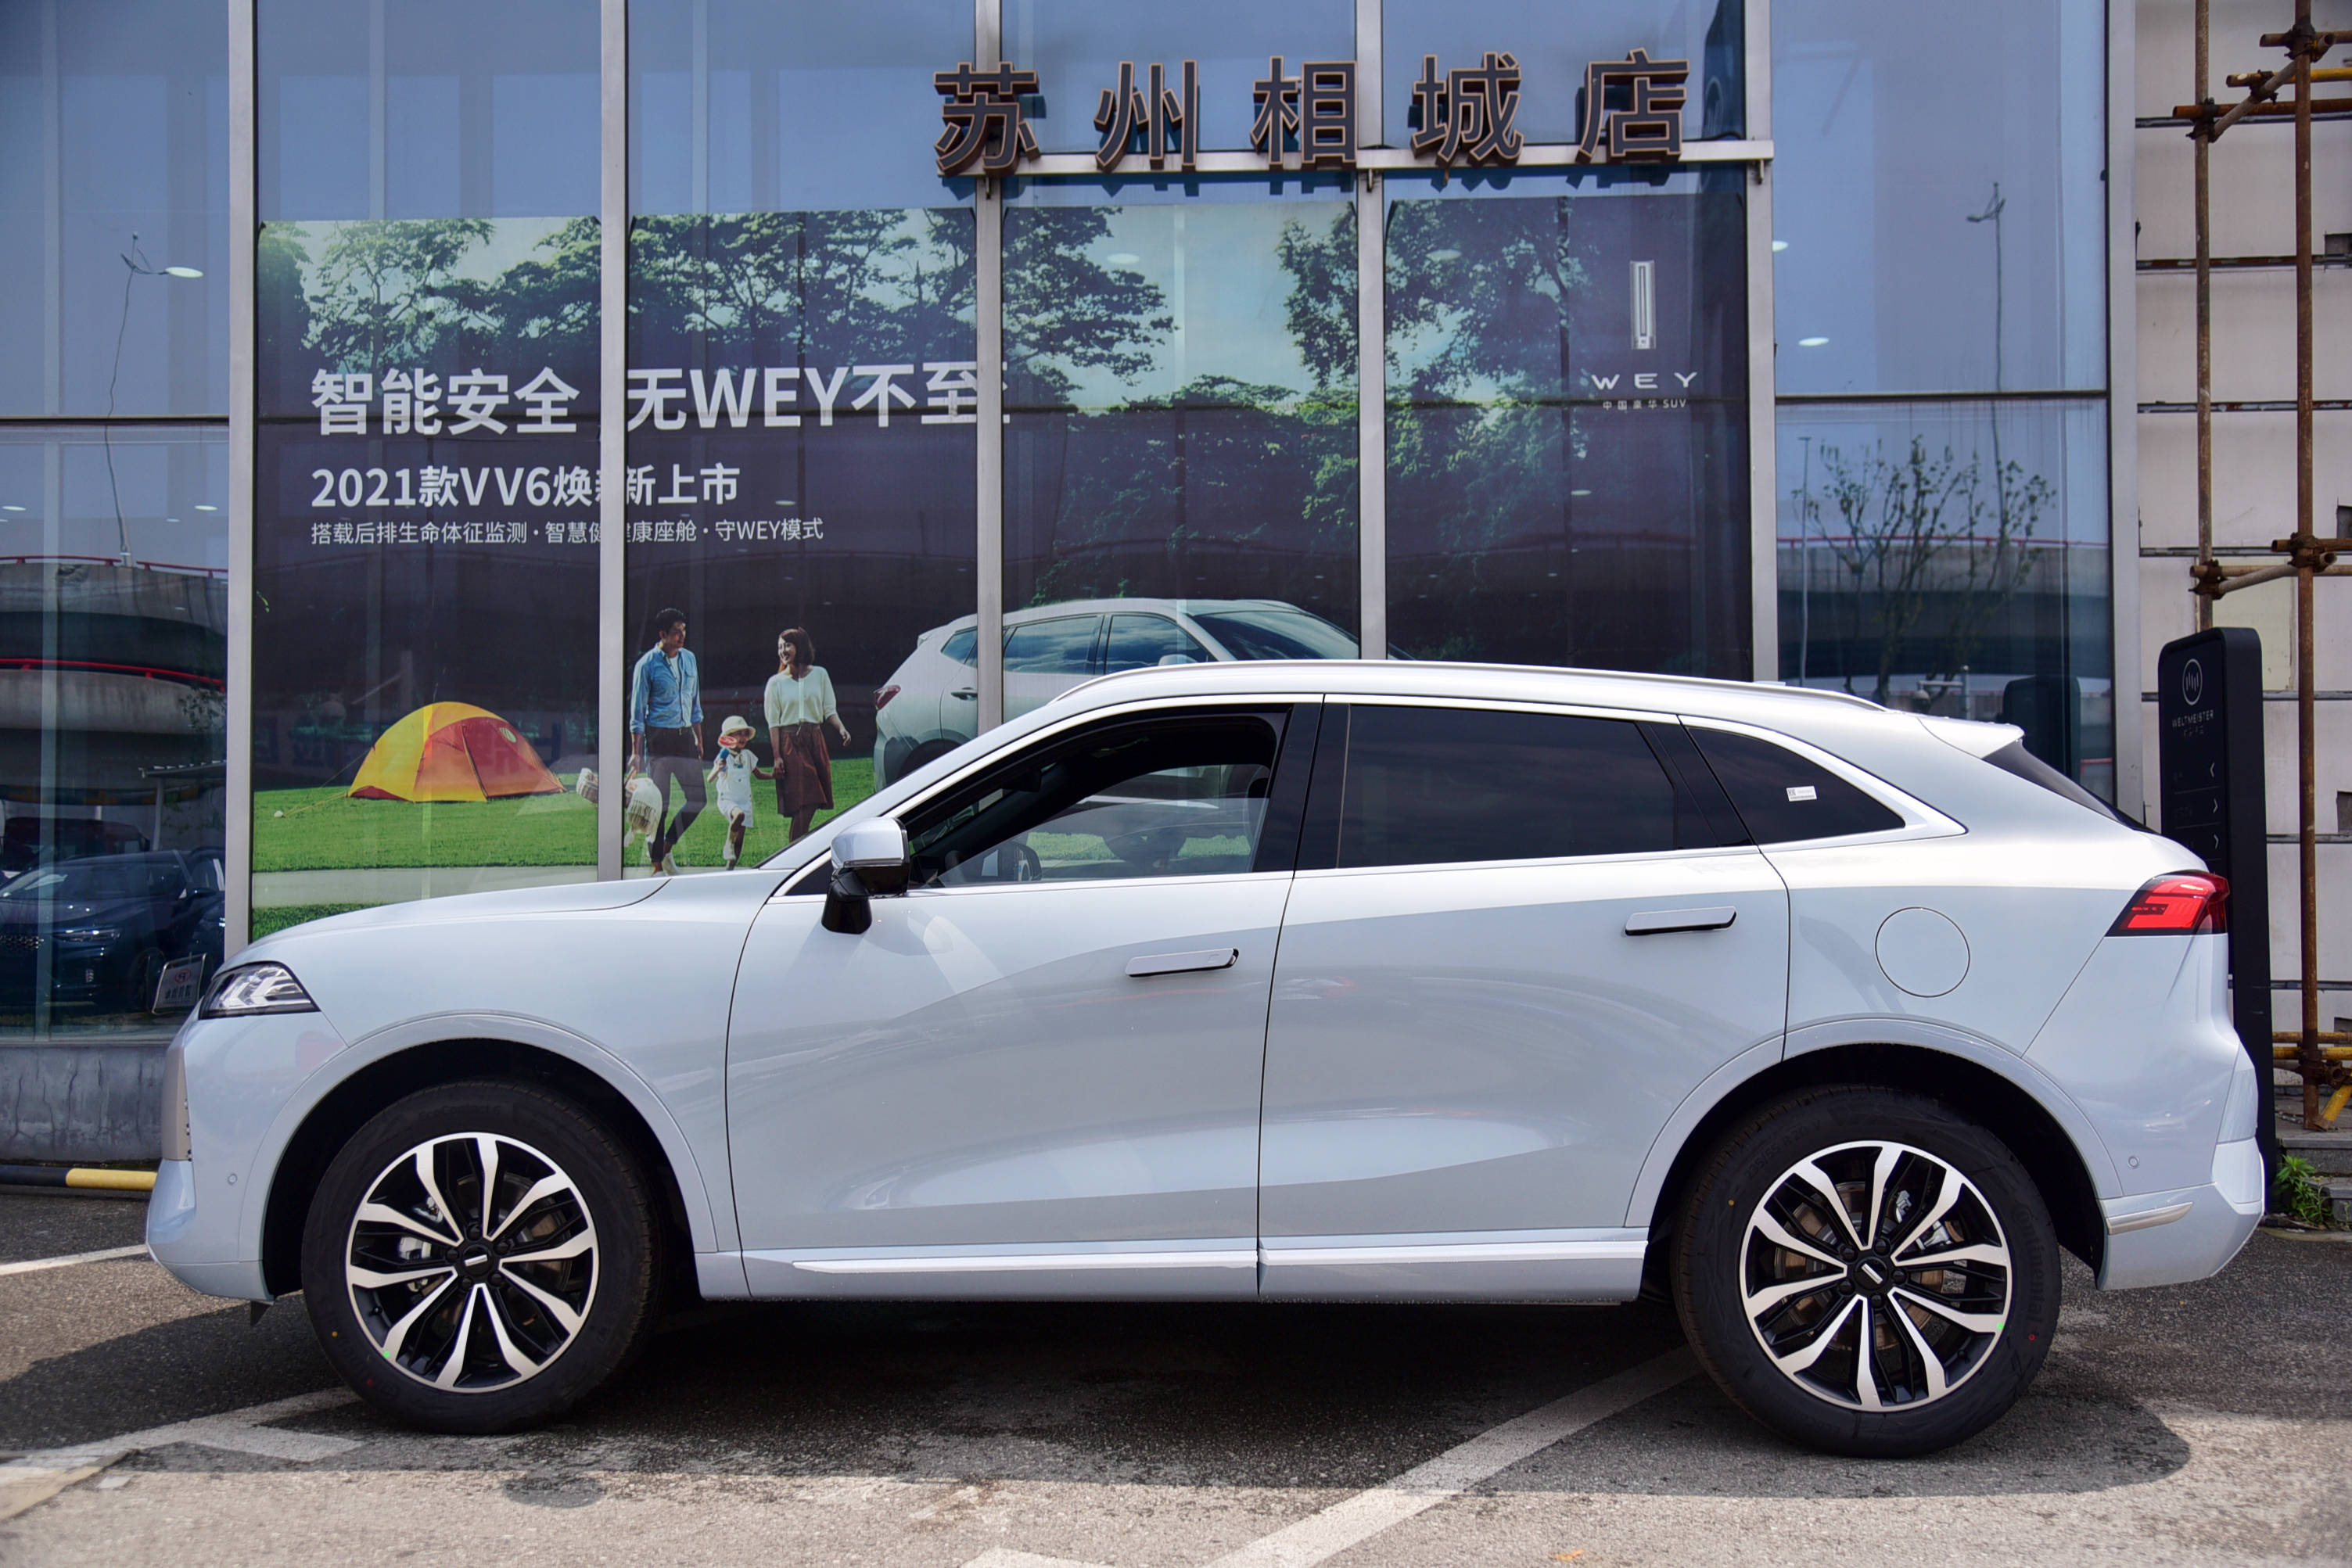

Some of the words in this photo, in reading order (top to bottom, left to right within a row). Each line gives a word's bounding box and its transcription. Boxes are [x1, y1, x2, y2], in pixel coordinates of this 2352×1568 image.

[934, 48, 1690, 174] 苏州相城店
[311, 365, 581, 436] 智能安全
[1591, 371, 1698, 390] WEY
